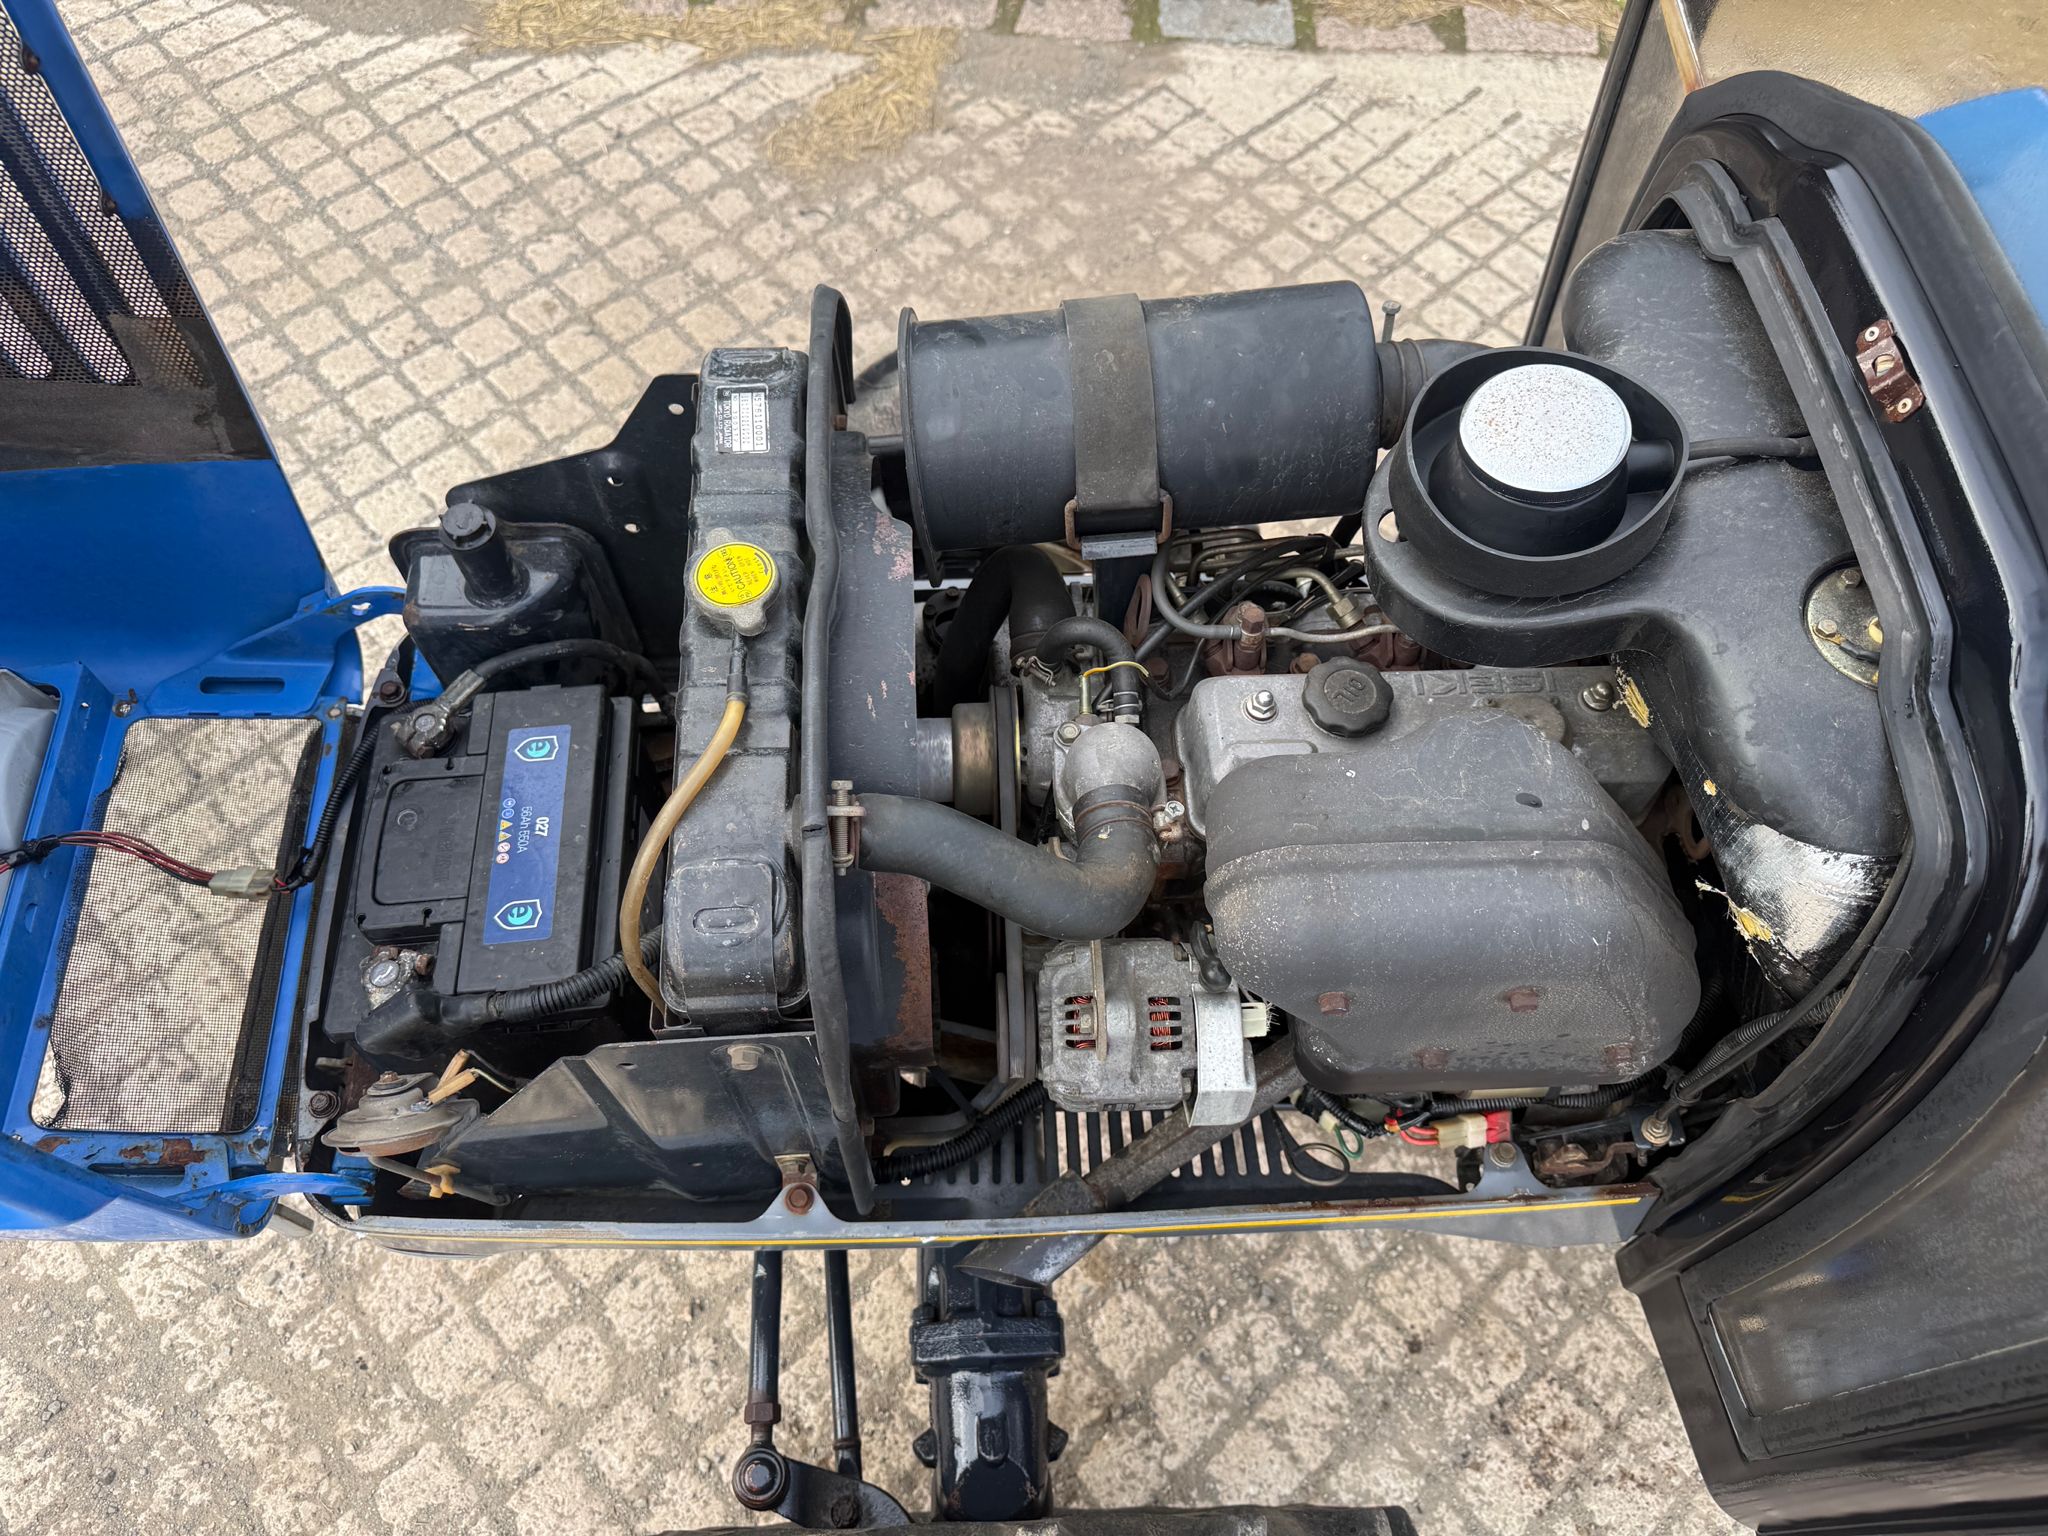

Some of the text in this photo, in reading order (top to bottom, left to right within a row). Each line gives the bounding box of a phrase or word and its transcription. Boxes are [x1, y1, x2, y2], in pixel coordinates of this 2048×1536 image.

[723, 400, 732, 449] TOKYO RADIATOR
[725, 556, 746, 590] CAUTION
[1331, 677, 1367, 703] OIL
[1412, 670, 1557, 696] ISEKI
[534, 816, 550, 837] 027
[516, 830, 530, 854] 550A
